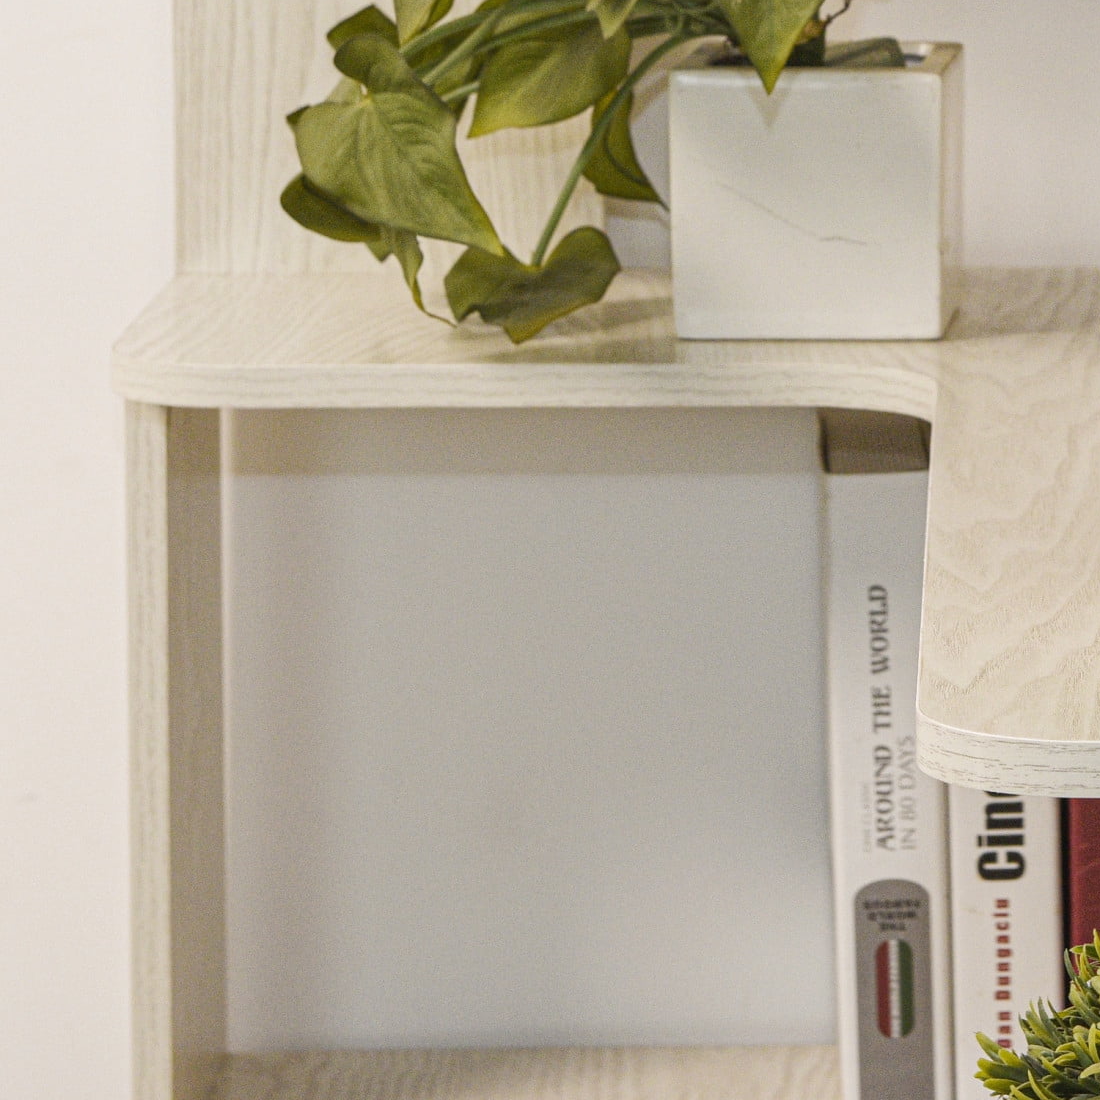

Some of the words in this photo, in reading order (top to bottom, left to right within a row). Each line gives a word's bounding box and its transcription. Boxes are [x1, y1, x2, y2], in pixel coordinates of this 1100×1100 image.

[868, 584, 891, 675] WORLD
[871, 685, 893, 733] THE
[872, 745, 896, 852] AROUND
[896, 734, 917, 790] DAYS
[898, 796, 917, 821] 80
[900, 827, 917, 851] IN
[977, 790, 1027, 881] Cin
[993, 899, 1013, 1000] Dungaciu
